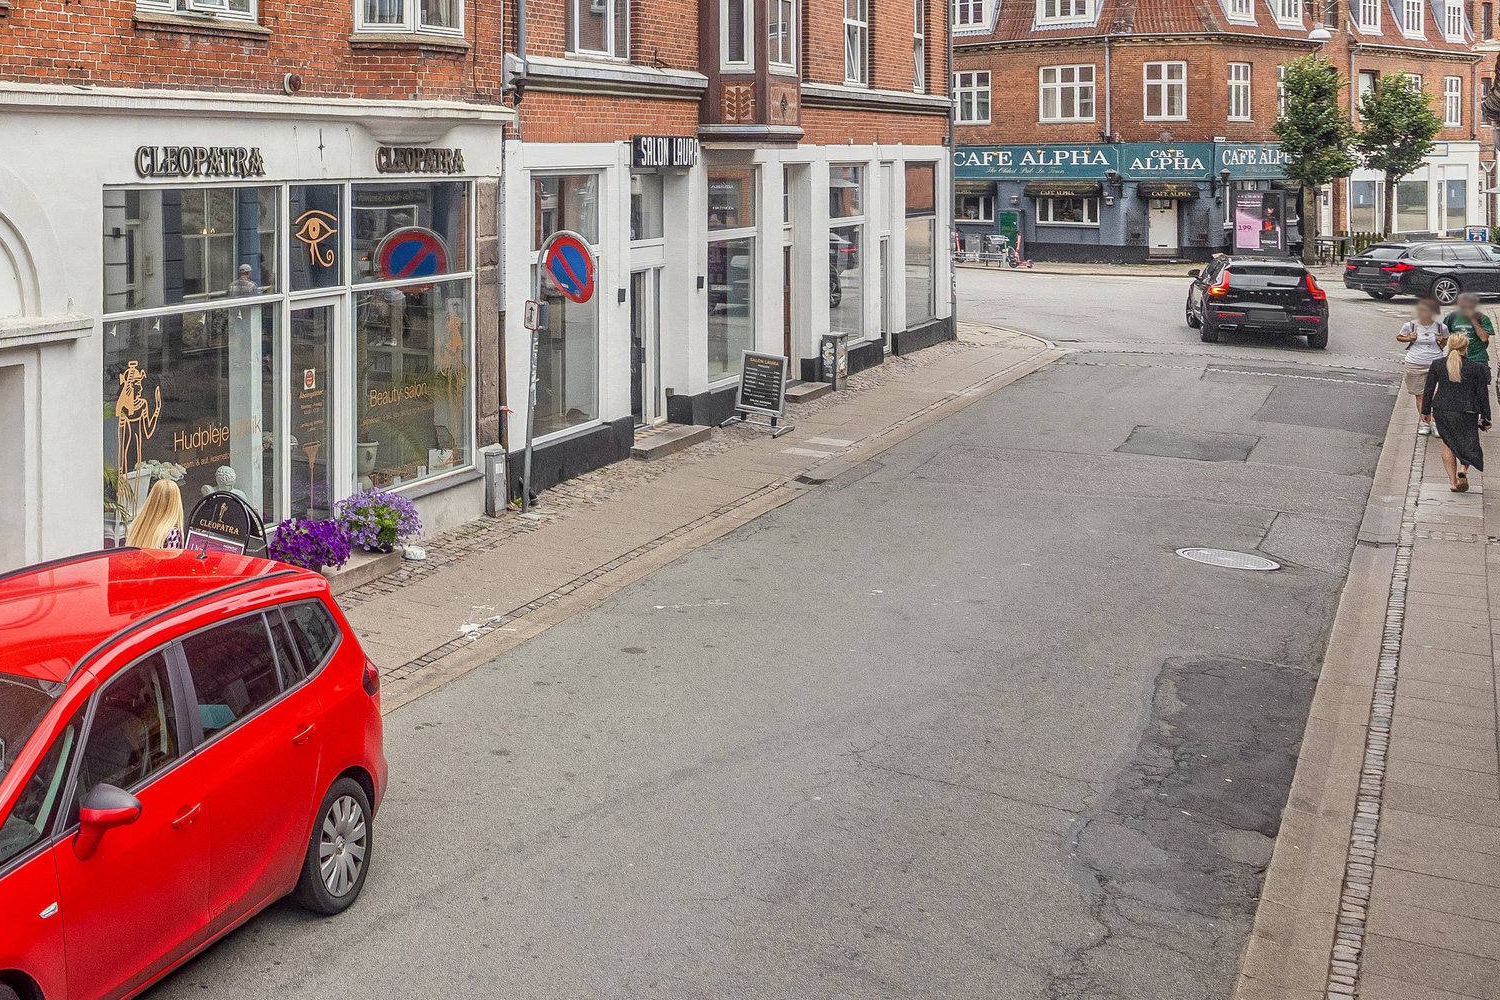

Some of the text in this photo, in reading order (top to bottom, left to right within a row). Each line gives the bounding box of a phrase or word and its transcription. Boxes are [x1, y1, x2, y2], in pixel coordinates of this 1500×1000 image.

[134, 145, 266, 178] CLEOPATRA
[375, 147, 466, 174] CLEOPATRA
[641, 137, 699, 165] SALON LAURA
[954, 150, 1110, 166] CAFE ALPHA
[1150, 150, 1184, 158] CAFE
[1222, 150, 1296, 165] CAFE ALPH
[1129, 158, 1205, 170] ALPHA
[370, 381, 428, 408] Beauty salon
[174, 422, 230, 452] Hudpleje
[200, 519, 239, 535] CLEOPATRA
